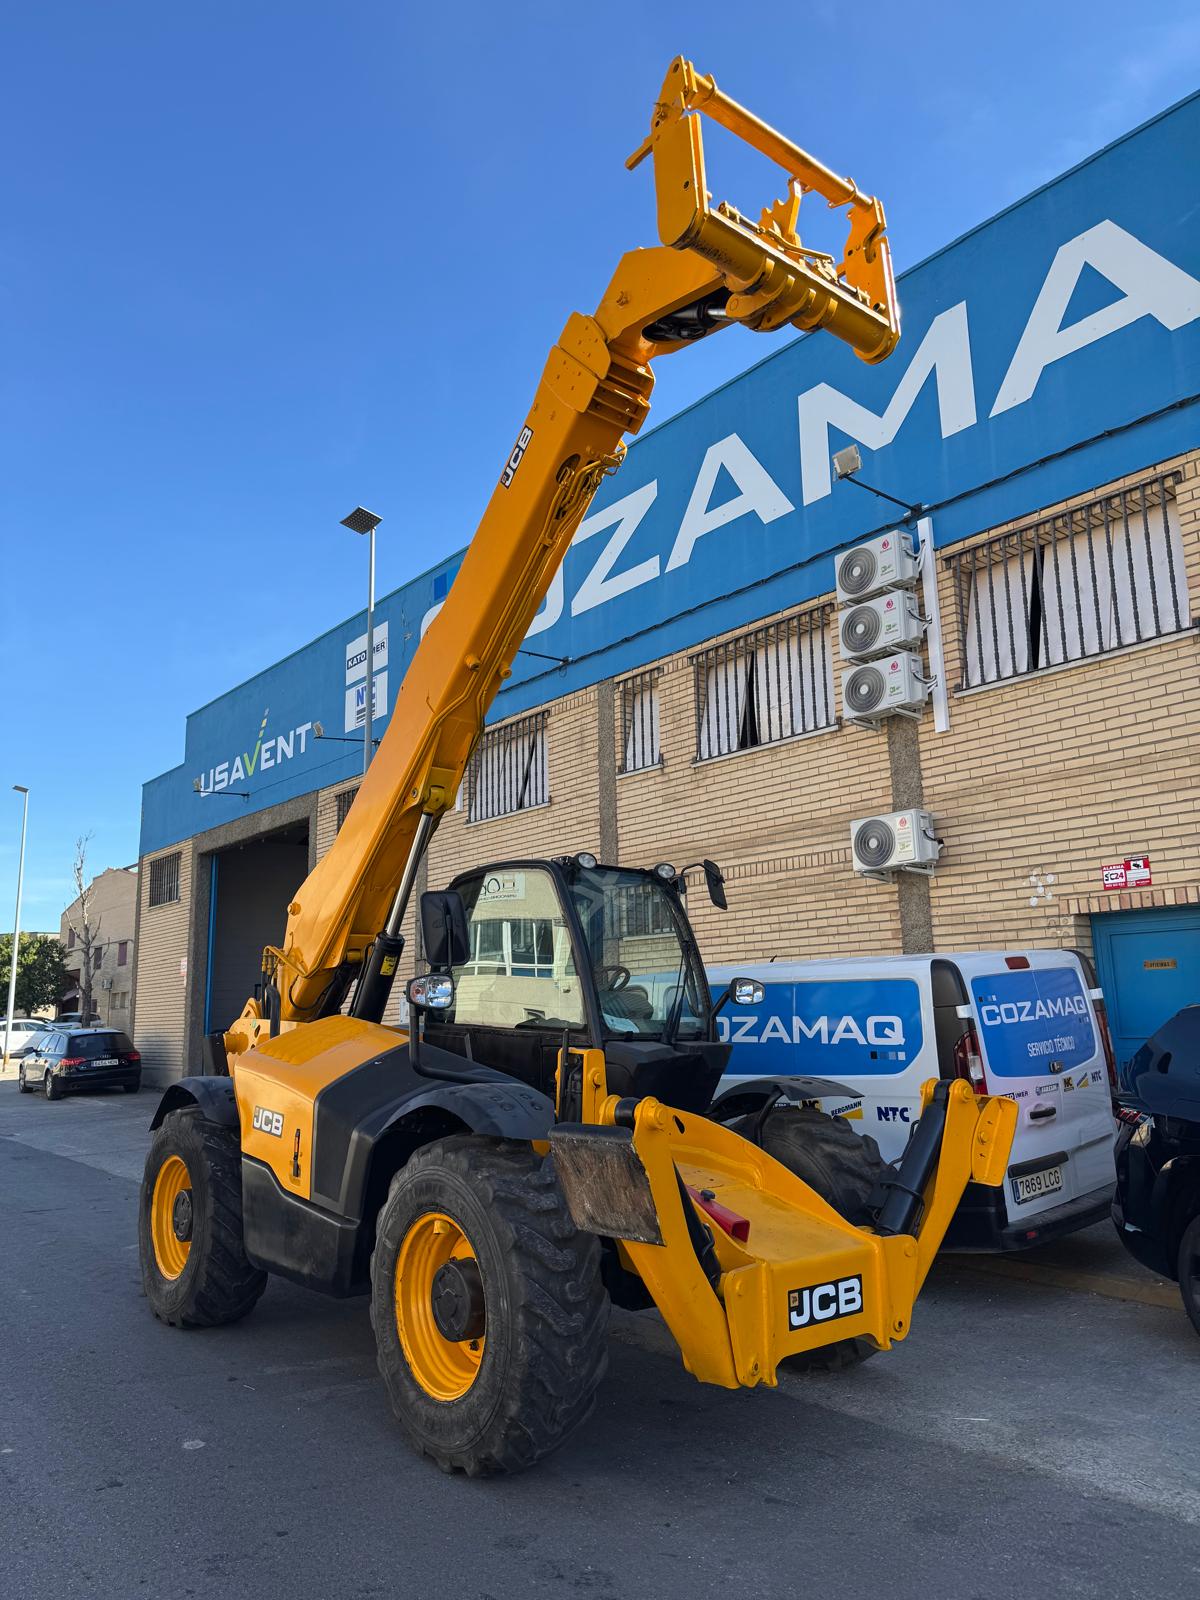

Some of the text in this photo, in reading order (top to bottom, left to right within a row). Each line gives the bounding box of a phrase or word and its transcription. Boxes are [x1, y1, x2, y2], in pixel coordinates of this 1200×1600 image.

[421, 218, 1200, 640] ZAMA
[505, 427, 532, 486] JCB
[347, 652, 366, 668] KATO
[200, 721, 312, 798] USAVENT
[981, 995, 1087, 1026] COZAMAQ
[1027, 1034, 1075, 1057] SERVICIO TÉCNICO
[253, 1108, 284, 1136] JCB
[830, 1101, 862, 1117] BERGMANN
[876, 1106, 910, 1122] NTC
[1019, 1170, 1060, 1196] 7869 LCG
[790, 1278, 862, 1326] JCB
